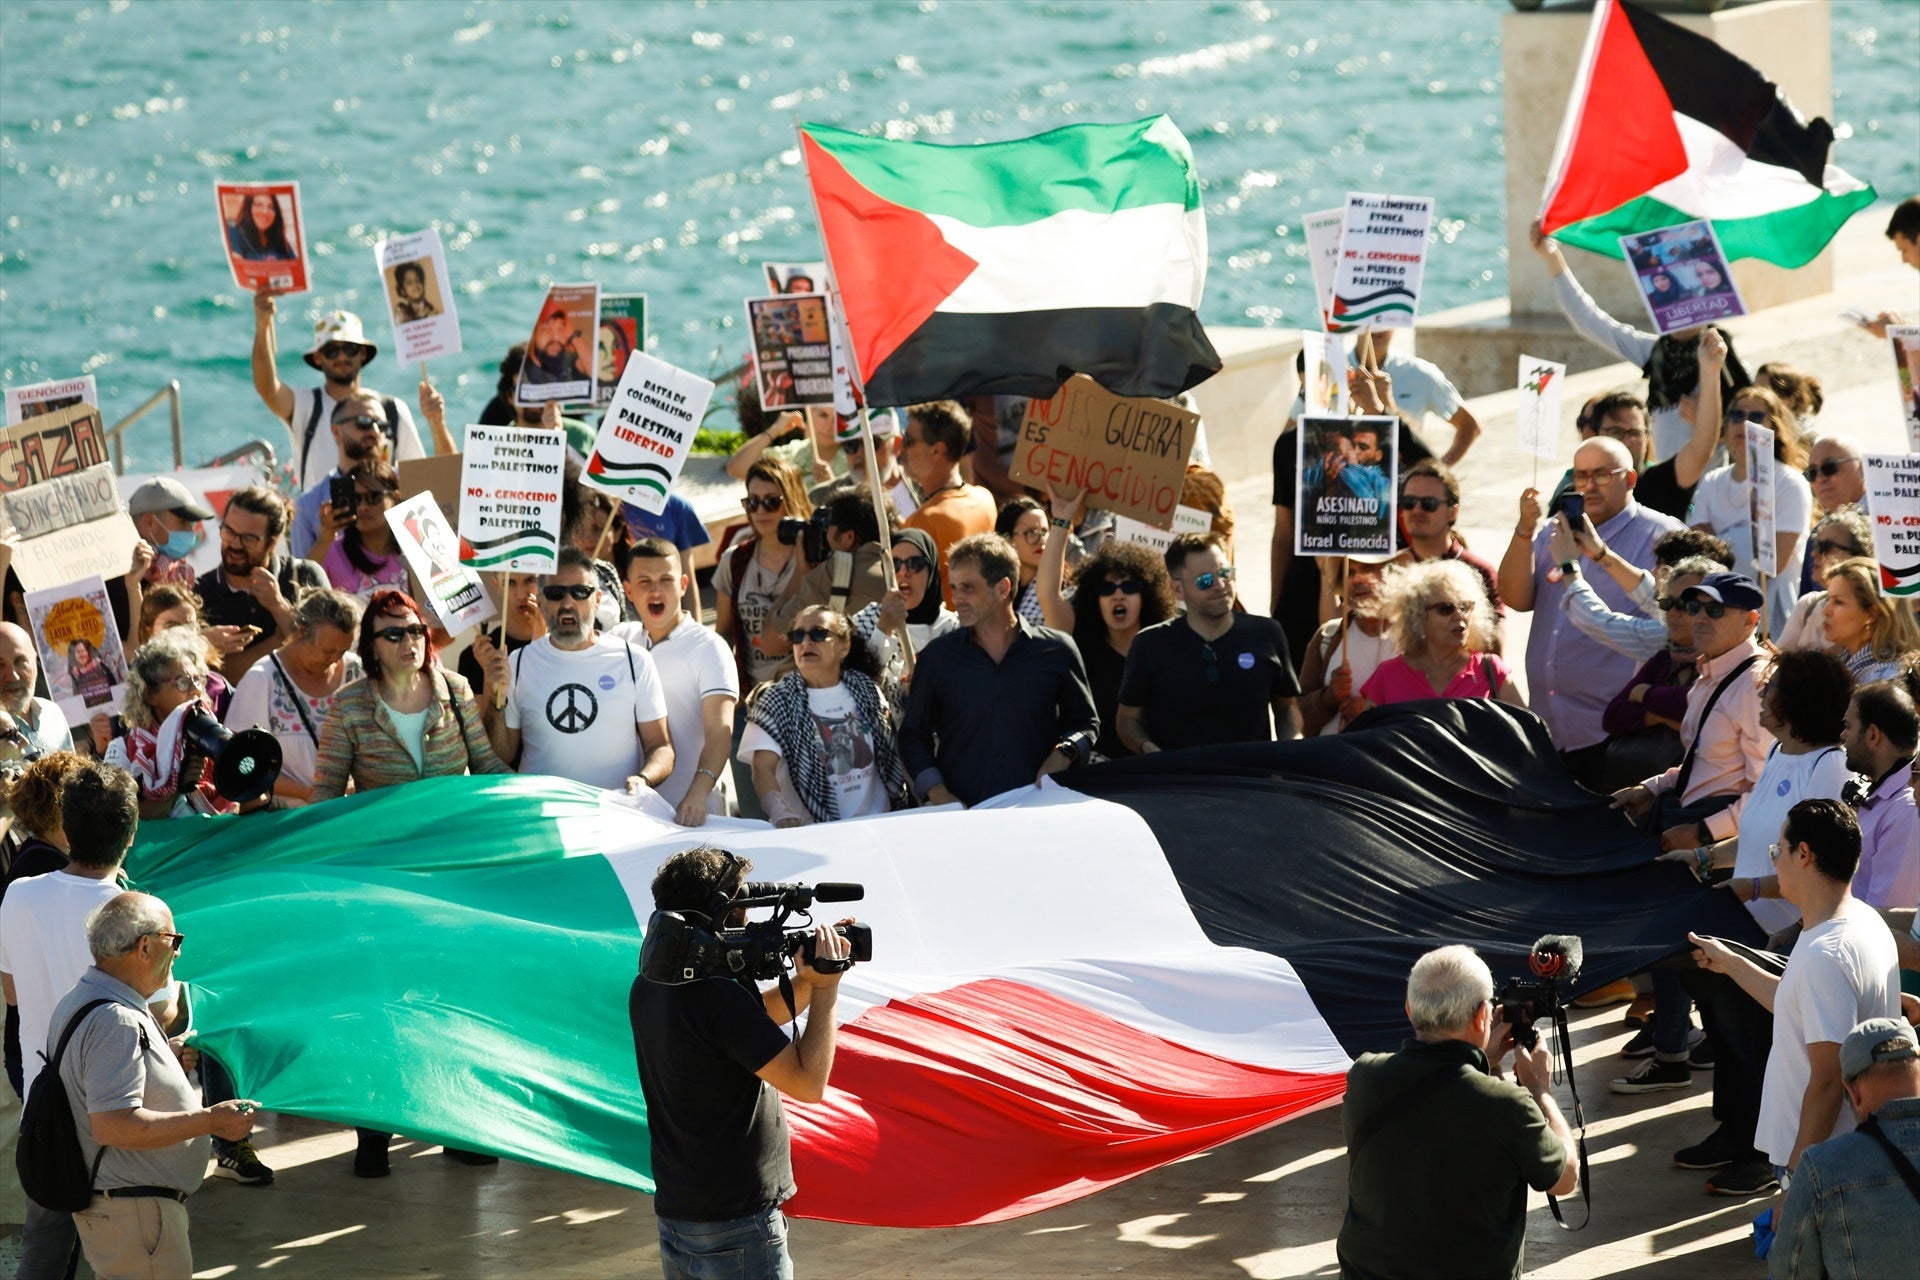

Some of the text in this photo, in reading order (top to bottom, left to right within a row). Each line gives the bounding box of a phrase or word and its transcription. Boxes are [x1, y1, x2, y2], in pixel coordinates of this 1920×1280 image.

[1352, 198, 1363, 207] NO
[1381, 200, 1427, 212] LIMPIEZA
[1366, 226, 1424, 237] PALESTINOS
[1345, 250, 1358, 258] NO
[1368, 252, 1421, 263] GENOCIDIO
[1367, 264, 1406, 275] PUEBLO
[1352, 277, 1405, 289] PALESTINO
[1665, 298, 1728, 319] LIBERTAD
[18, 382, 85, 401] GENOCIDIO
[644, 380, 686, 404] BASTA DE
[627, 388, 692, 422] COLONIALISMO
[619, 408, 683, 444] PALESTINA
[1025, 422, 1050, 443] ES
[1106, 402, 1183, 460] GUERRA
[470, 431, 485, 440] NO
[507, 432, 560, 446] LIMPIEZA
[614, 425, 674, 458] LIBERTAD
[0, 415, 102, 492] GAZA
[494, 443, 534, 458] ÉTNICA
[491, 461, 558, 474] PALESTINOS
[1868, 458, 1882, 468] NO
[1902, 459, 1920, 470] LIM
[468, 488, 483, 497] NO
[495, 490, 557, 502] GENOCIDIO
[1894, 488, 1920, 498] PALE
[496, 504, 540, 516] PUEBLO
[1317, 496, 1378, 514] ASESINATO
[480, 517, 541, 530] PALESTINO
[1176, 514, 1206, 528] ESTINA
[1317, 514, 1378, 526] NIÑOS PALESTINOS
[1877, 516, 1892, 525] NO
[1902, 516, 1920, 526] GEN
[1304, 532, 1388, 549] Israel Genocida
[1907, 532, 1920, 541] PU
[1894, 544, 1920, 554] PALE
